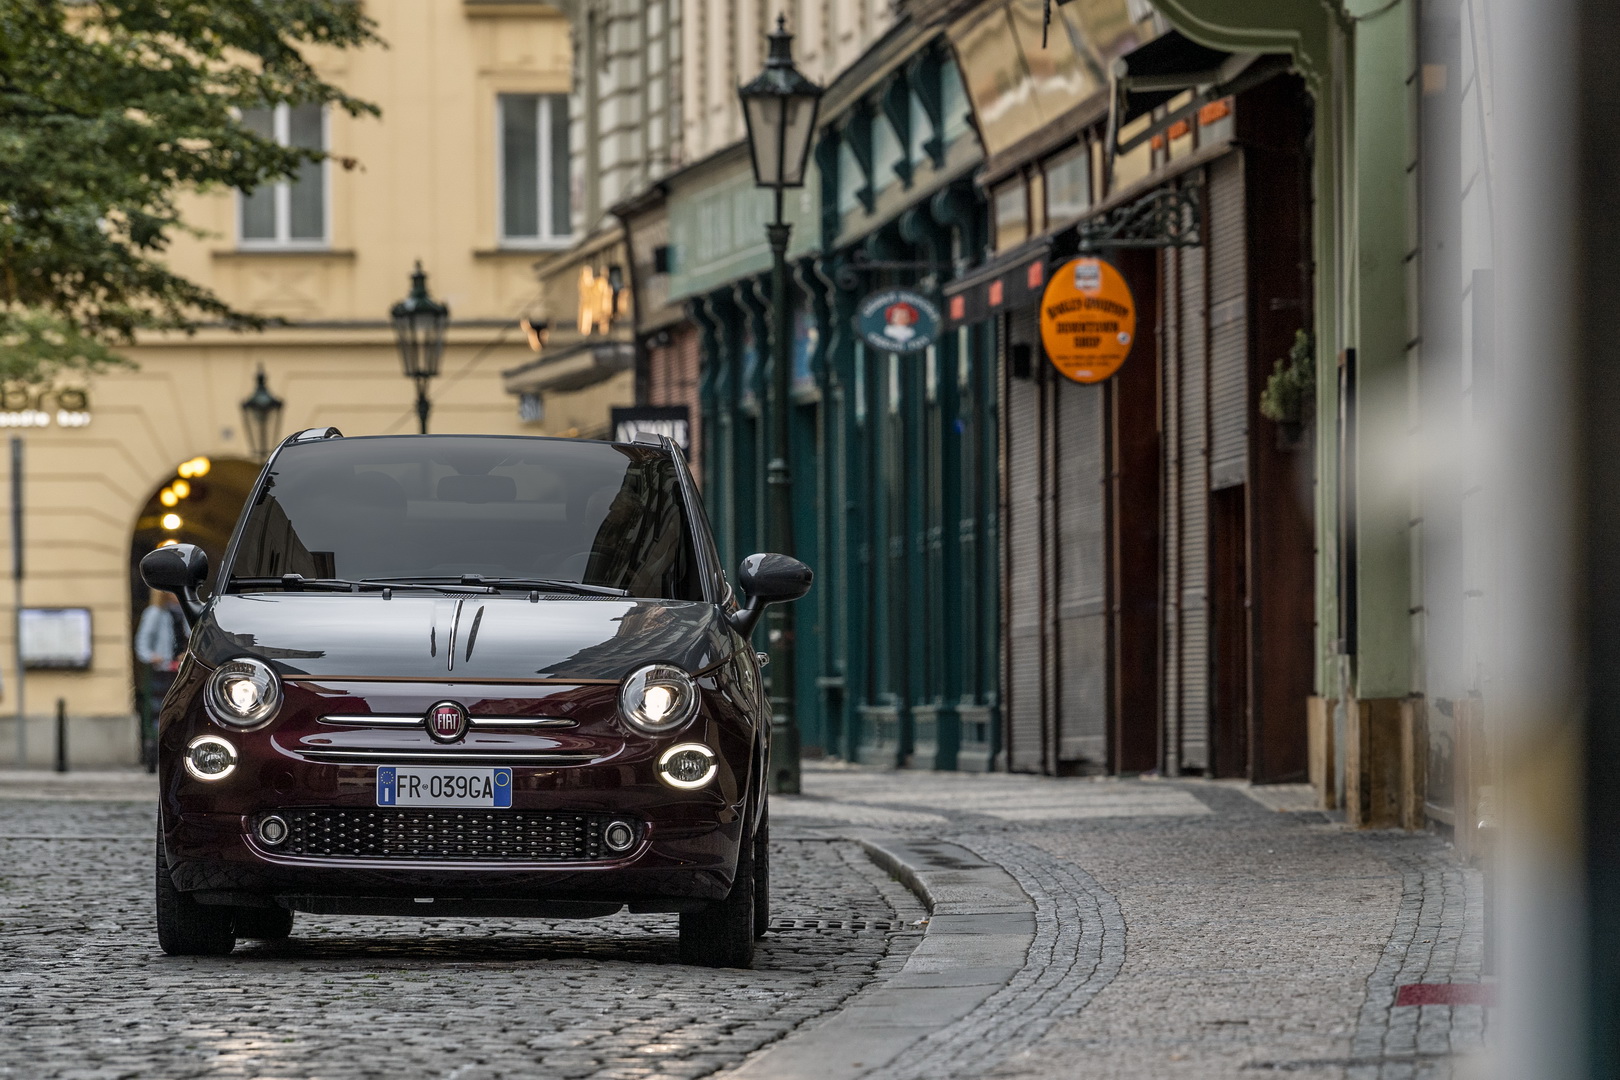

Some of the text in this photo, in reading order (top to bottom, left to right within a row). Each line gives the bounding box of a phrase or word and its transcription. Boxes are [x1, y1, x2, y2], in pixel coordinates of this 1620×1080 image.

[437, 713, 458, 730] FIAT
[396, 775, 494, 799] FR 039GA
